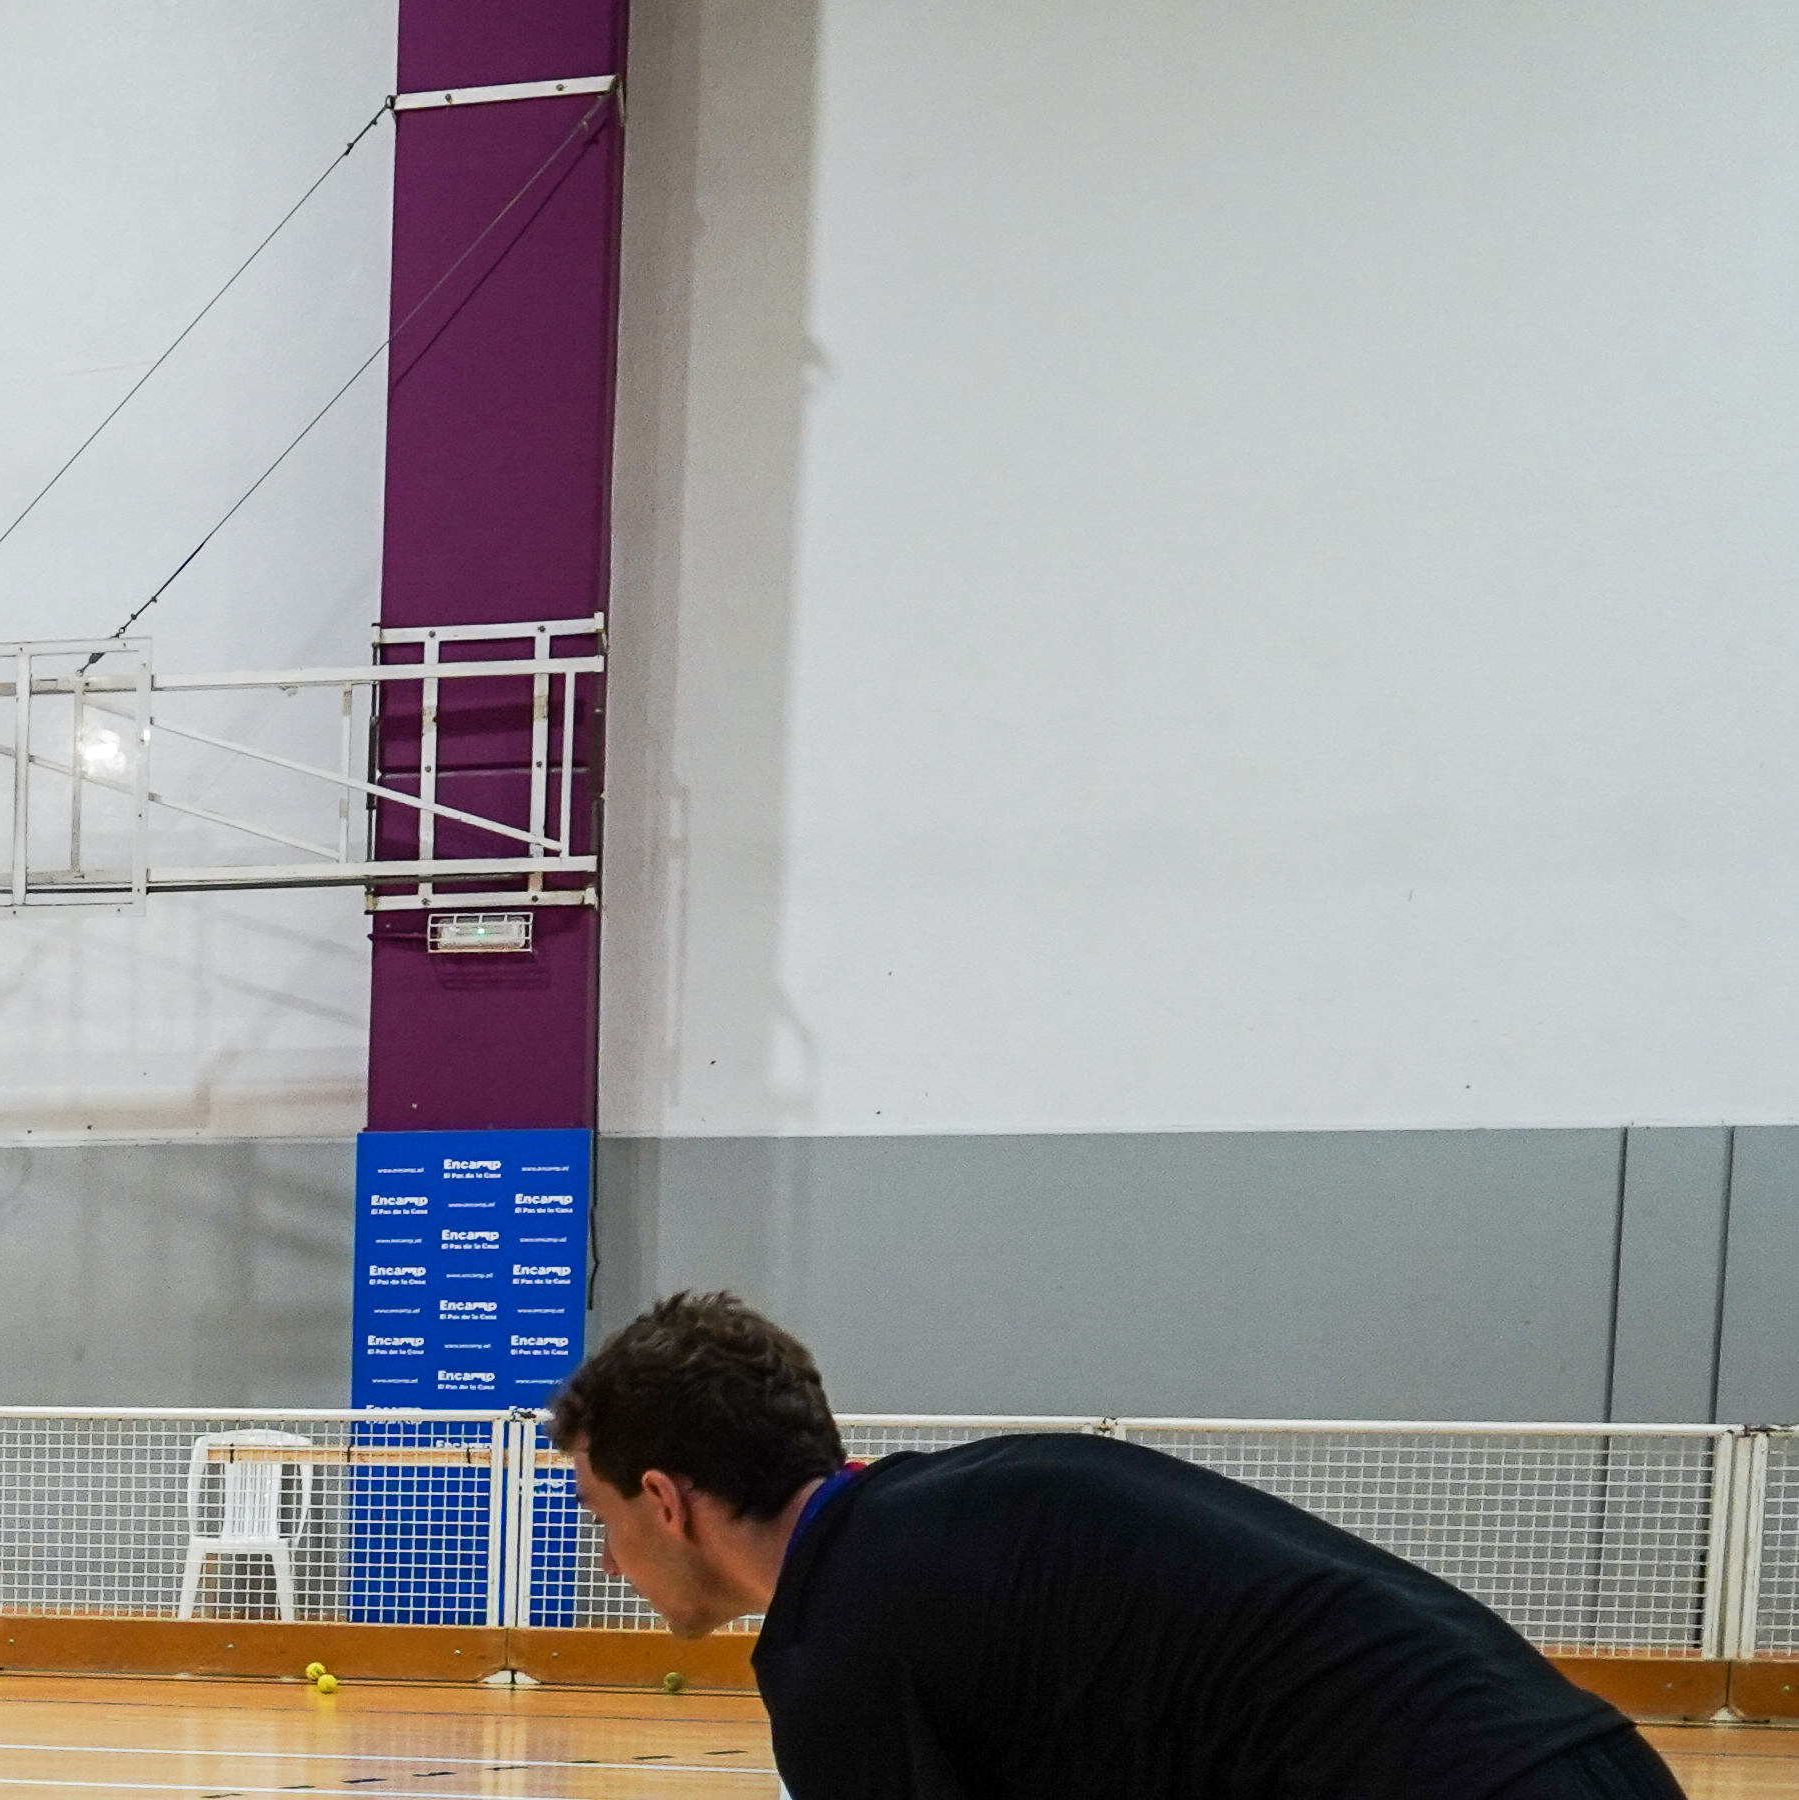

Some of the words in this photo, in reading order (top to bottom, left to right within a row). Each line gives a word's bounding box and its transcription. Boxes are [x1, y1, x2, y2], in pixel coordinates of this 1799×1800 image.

[444, 1159, 501, 1170] Encamp
[371, 1195, 428, 1206] Encamp
[515, 1194, 573, 1205] Encamp
[442, 1229, 499, 1241] Encamp
[370, 1265, 426, 1276] Encamp
[513, 1265, 571, 1276] Encamp
[440, 1300, 497, 1311] Encamp
[368, 1335, 424, 1346] Encamp
[511, 1335, 568, 1347] Encamp
[438, 1371, 495, 1382] Encamp
